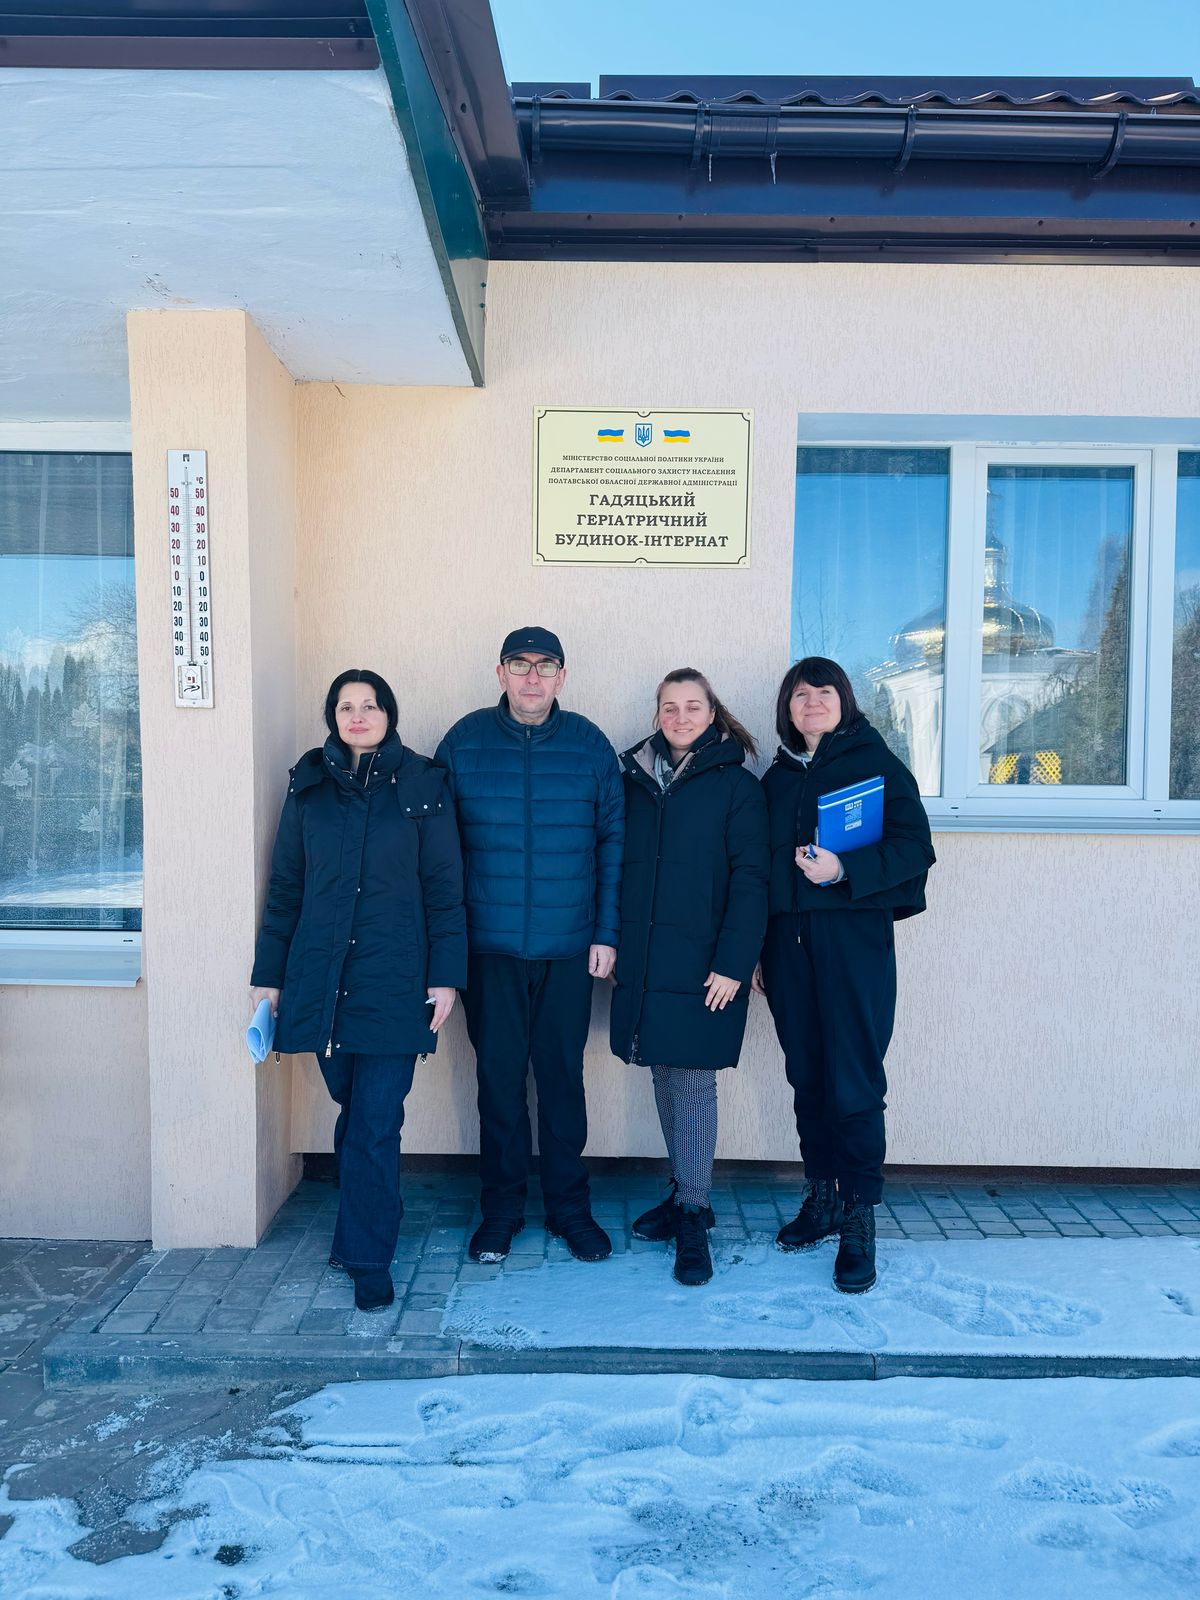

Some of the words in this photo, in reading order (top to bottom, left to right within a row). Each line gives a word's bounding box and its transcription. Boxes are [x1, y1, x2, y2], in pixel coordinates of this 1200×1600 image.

[614, 455, 656, 464] СОЦІАЛЬНОЇ
[694, 456, 724, 464] УКРАЇНИ
[550, 467, 604, 475] ДЕПАРТАМЕНТ
[605, 468, 657, 476] СОЦІАЛЬНОГО
[548, 478, 599, 486] ПОЛТАВСЬКОЇ
[600, 478, 637, 487] ОБЛАСНОЇ
[637, 479, 681, 487] ДЕРЖАВНОЇ
[170, 488, 179, 498] 50
[195, 488, 205, 498] 50
[589, 492, 696, 508] ГАДЯЦЬКИЙ
[170, 506, 180, 516] 40
[195, 506, 205, 516] 40
[576, 512, 708, 527] ГЕРІАТРИЧНИЙ
[171, 523, 180, 533] 30
[196, 523, 206, 533] 30
[171, 539, 181, 549] 20
[197, 540, 206, 550] 20
[554, 533, 729, 548] БУДИНОК-ІНТЕРНАТ
[172, 555, 181, 565] 10
[198, 556, 207, 566] 10
[175, 570, 180, 581] 0
[199, 571, 205, 582] 0
[173, 585, 182, 596] 10
[199, 586, 208, 597] 10
[173, 601, 183, 611] 20
[199, 602, 208, 612] 20
[174, 616, 183, 627] 30
[199, 617, 209, 627] 30
[174, 631, 184, 641] 40
[200, 632, 209, 642] 40
[175, 646, 184, 656] 50
[200, 646, 210, 657] 50
